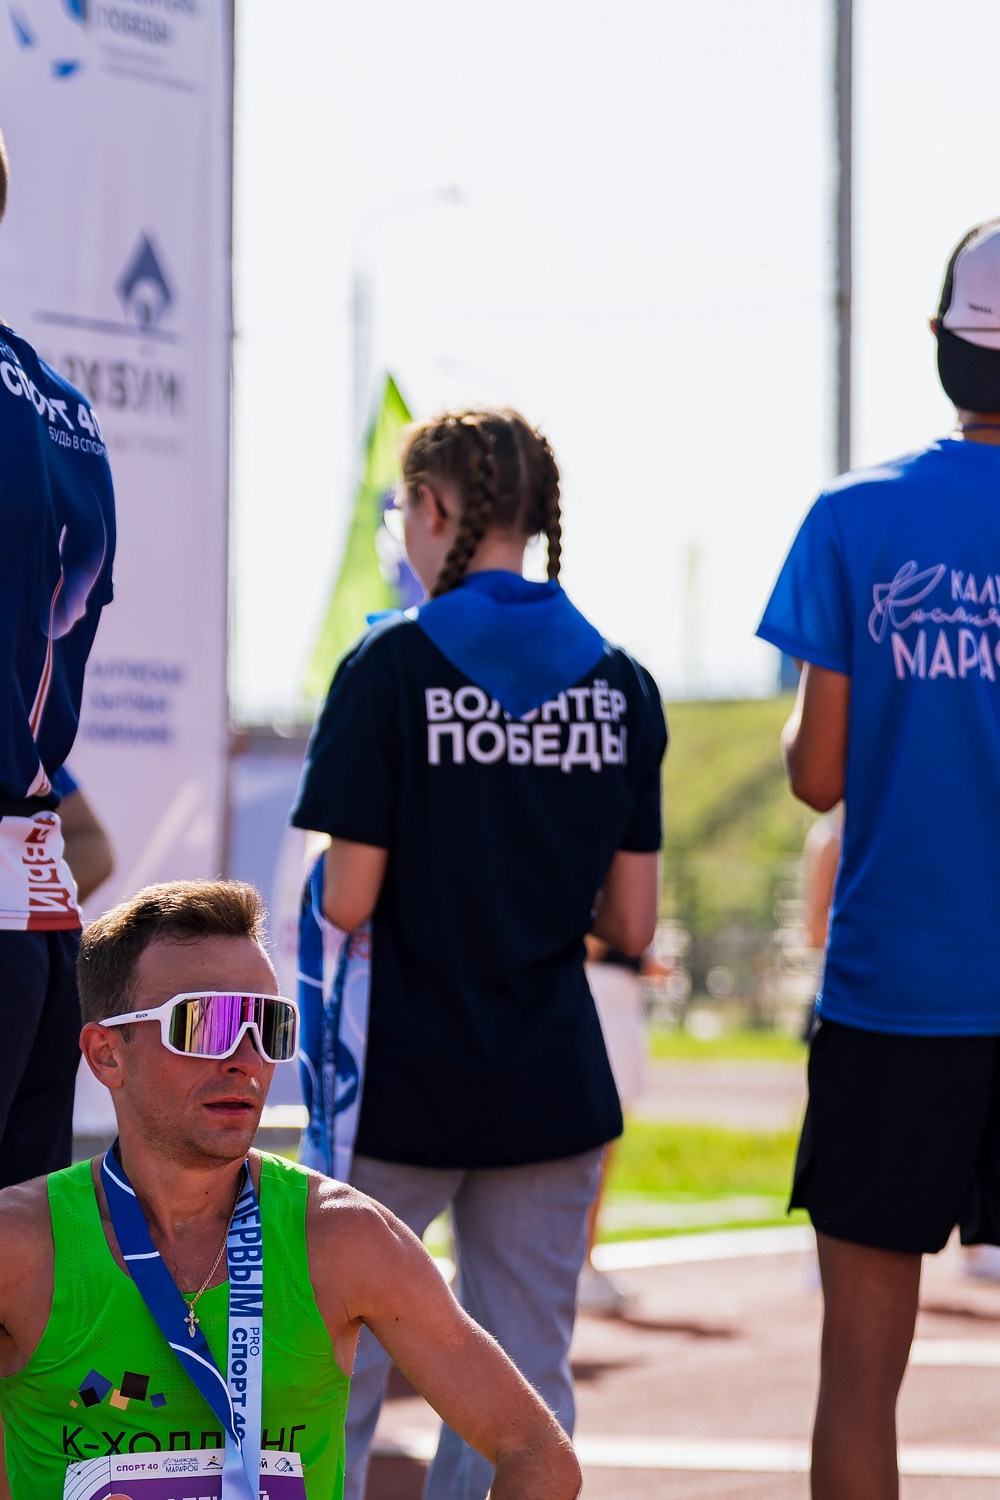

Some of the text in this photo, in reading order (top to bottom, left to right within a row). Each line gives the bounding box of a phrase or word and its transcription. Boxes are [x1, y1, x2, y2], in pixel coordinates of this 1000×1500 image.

[48, 426, 72, 447] БУДЬ
[950, 568, 1000, 606] КАЛ
[424, 679, 628, 722] ВОНТЁР
[427, 721, 628, 774] ПОБЕДЫ
[228, 1189, 263, 1318] ПЕРВЫМ
[249, 1327, 260, 1357] PRO
[230, 1327, 248, 1408] СПОРТ
[116, 1464, 146, 1472] СПОРТ
[165, 1465, 198, 1473] МАРАФОН
